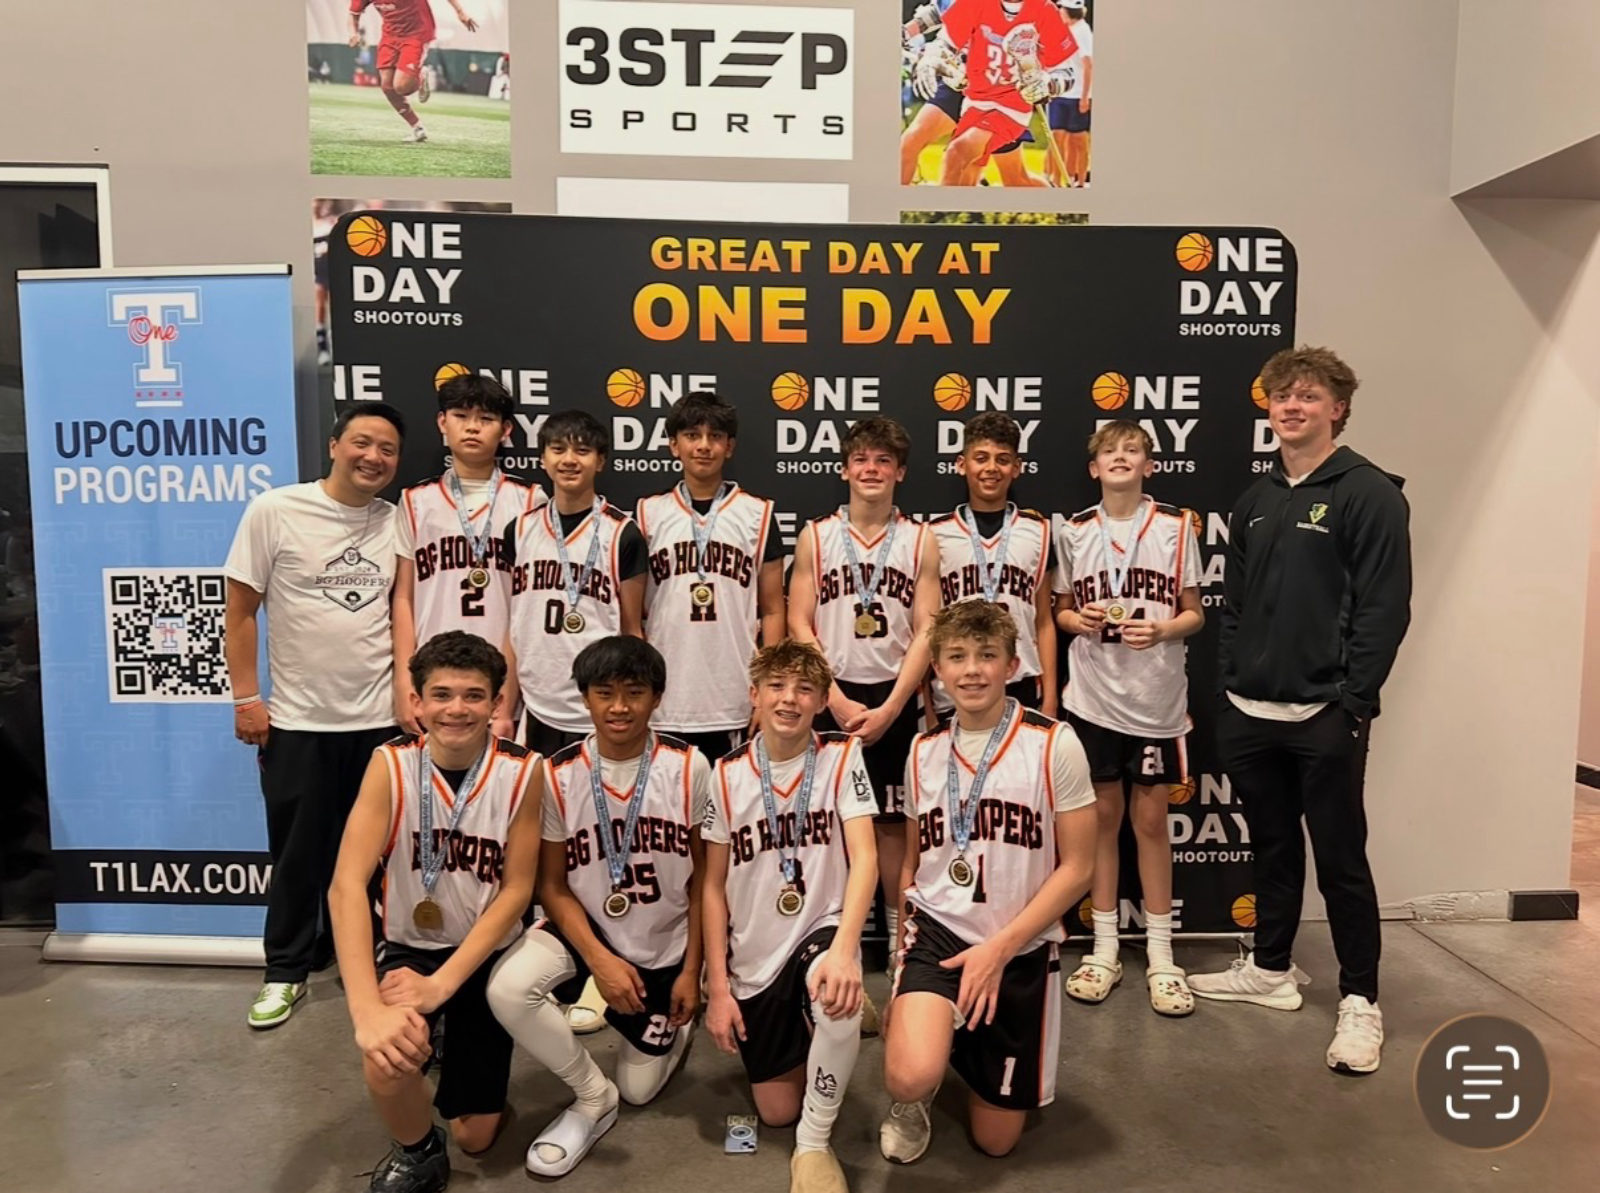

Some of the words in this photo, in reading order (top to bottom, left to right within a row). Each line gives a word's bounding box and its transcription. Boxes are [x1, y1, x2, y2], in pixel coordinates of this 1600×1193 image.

[569, 108, 845, 135] SPORTS
[651, 236, 811, 273] GREAT
[828, 241, 923, 274] DAY
[938, 242, 1000, 275] AT
[352, 265, 463, 304] DAY
[1180, 280, 1284, 316] DAY
[128, 315, 178, 346] One
[353, 310, 463, 327] SHOOTOUTS
[633, 282, 807, 343] ONE
[842, 287, 1011, 344] DAY
[1179, 323, 1281, 336] SHOOTOUTS
[55, 417, 267, 459] UPCOMING
[938, 420, 1041, 454] DY
[54, 463, 273, 504] PROGRAMS
[460, 579, 485, 616] 2
[820, 569, 839, 606] BG
[940, 571, 960, 606] BG
[918, 806, 944, 853] BG
[89, 861, 274, 895] T1LAX.COM
[1000, 1057, 1017, 1096] 1
